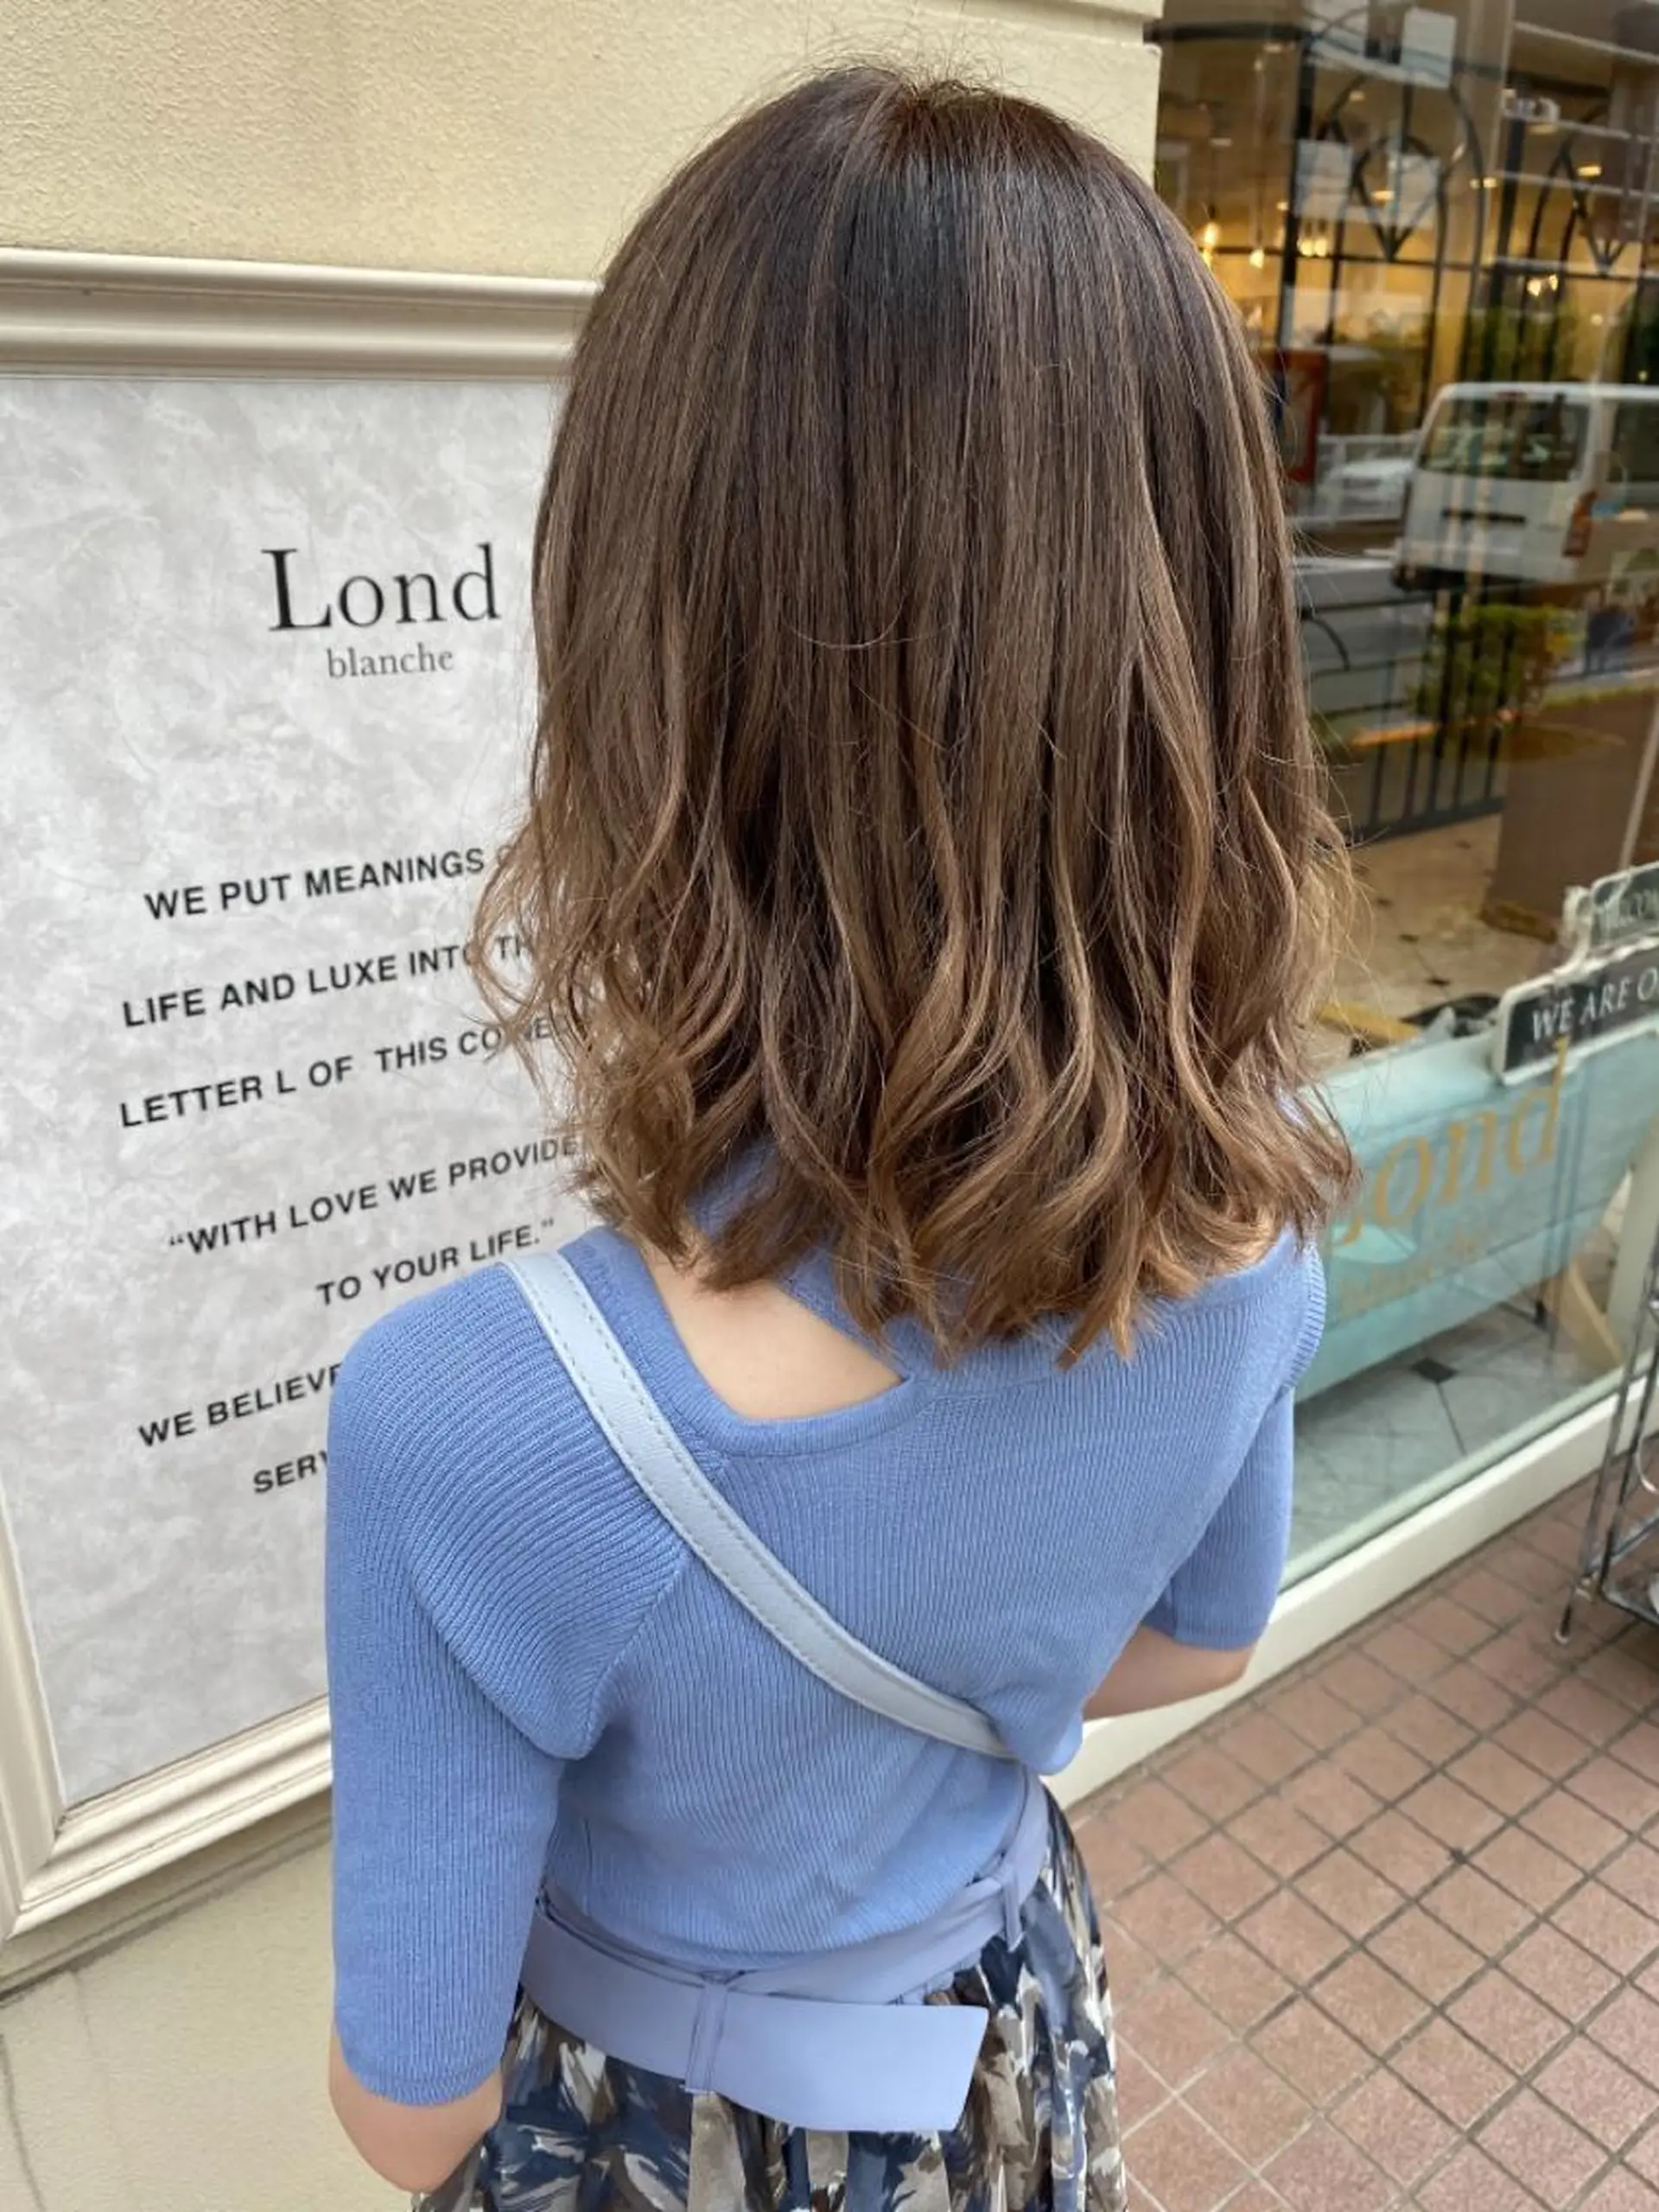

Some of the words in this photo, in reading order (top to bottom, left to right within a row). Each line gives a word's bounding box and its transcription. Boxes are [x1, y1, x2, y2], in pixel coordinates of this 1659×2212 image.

[261, 542, 500, 632] Lond
[327, 642, 454, 678] blanche
[143, 886, 207, 920] WE
[219, 874, 291, 911] PUT
[304, 847, 486, 899] MEANINGS
[122, 988, 207, 1028] LIFE
[220, 973, 296, 1011] AND
[308, 955, 397, 995] LUXE
[1532, 997, 1574, 1042] WE
[1580, 976, 1631, 1027] ARE
[119, 1075, 263, 1128] LETTER
[276, 1070, 297, 1095] L
[308, 1055, 353, 1089] OF
[373, 1034, 448, 1073] THIS
[1341, 1035, 1569, 1245] ond
[289, 1184, 378, 1229] LOVE
[388, 1169, 438, 1199] WE
[448, 1135, 578, 1187] PROVIDE
[315, 1275, 361, 1306] TO
[372, 1246, 460, 1290] YOUR
[137, 1410, 197, 1447] WE
